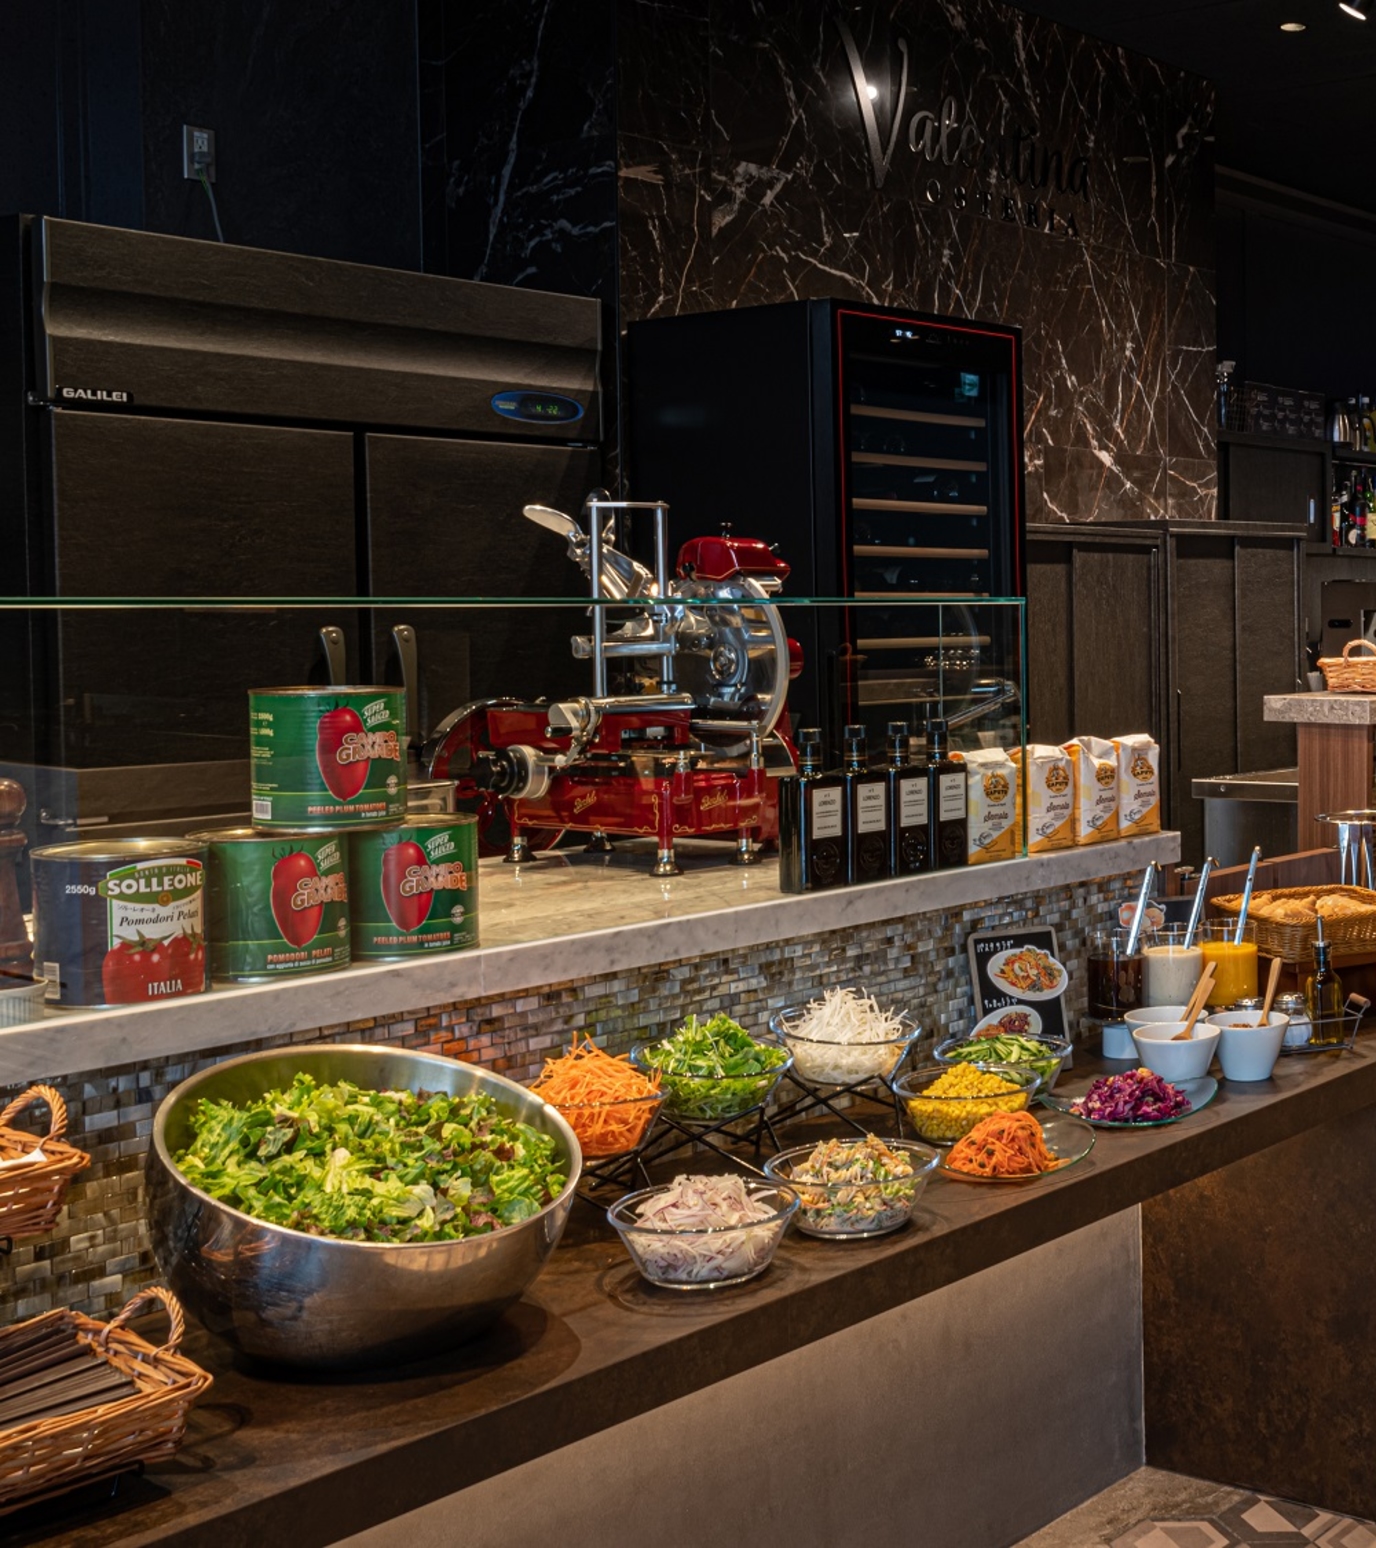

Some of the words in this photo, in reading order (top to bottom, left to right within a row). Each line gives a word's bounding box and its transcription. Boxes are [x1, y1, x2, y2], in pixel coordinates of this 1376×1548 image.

[926, 178, 1080, 238] OSTERIA
[62, 387, 128, 402] GALILEI
[342, 730, 397, 747] CAMPO
[336, 742, 401, 765] GRANDE
[1096, 773, 1115, 781] CAPUTO
[1134, 769, 1154, 777] CAPUTO
[986, 788, 1008, 796] CAPUTO
[1047, 780, 1069, 788] CAPUTO
[307, 805, 334, 815] PEELED
[335, 804, 355, 814] PLUM
[405, 861, 463, 879] CAMPO
[65, 884, 96, 896] 2550g
[107, 870, 203, 896] SOLLEONE
[400, 872, 468, 897] GRANDE
[119, 913, 174, 927] Pomodori
[177, 907, 199, 921] Pelati
[373, 935, 398, 946] PEELED
[398, 934, 418, 945] PLUM
[267, 951, 308, 963] POMODORI
[311, 947, 333, 958] PELATI
[148, 979, 183, 996] ITALIA
